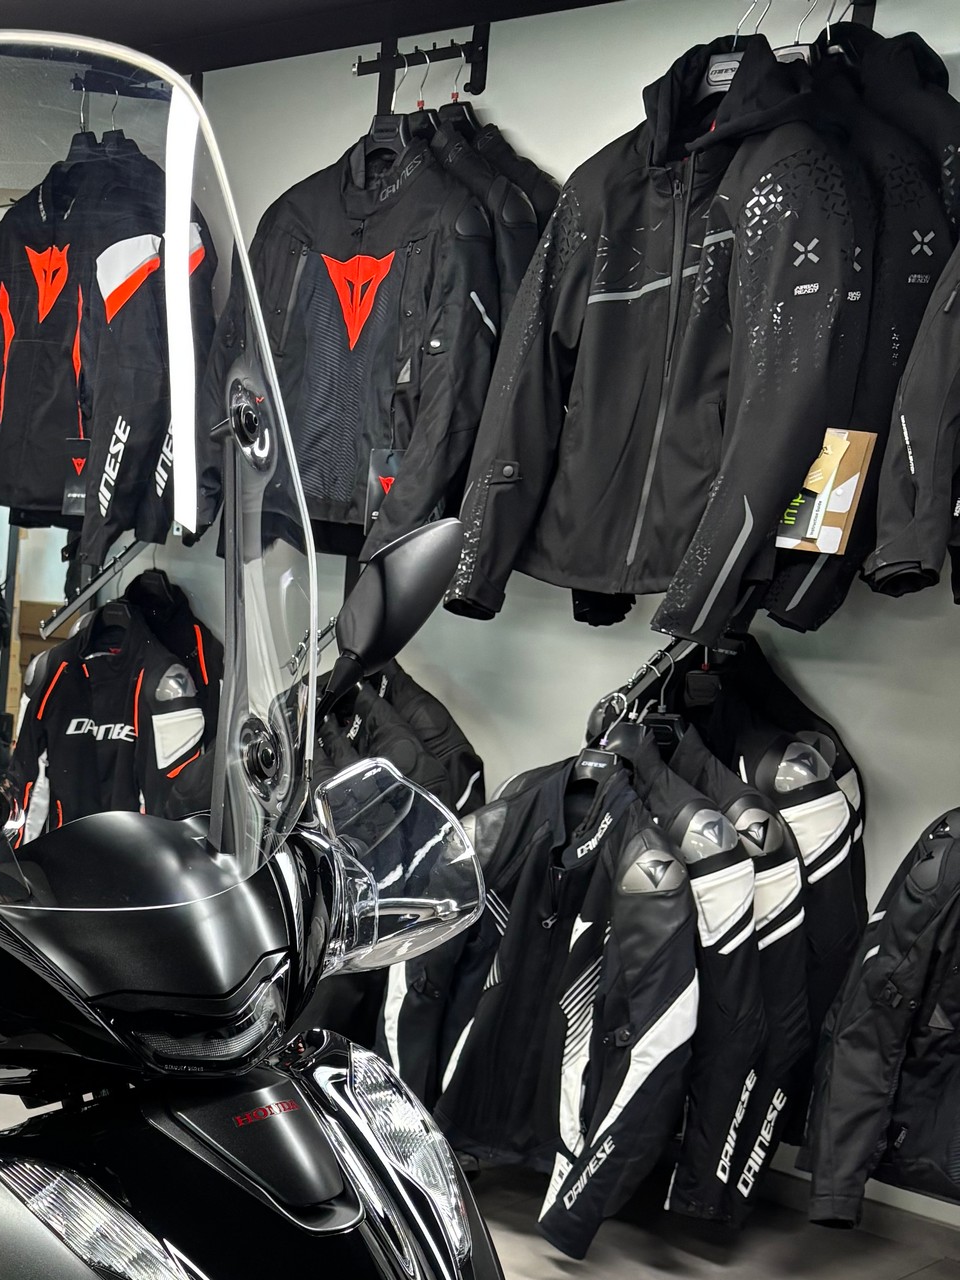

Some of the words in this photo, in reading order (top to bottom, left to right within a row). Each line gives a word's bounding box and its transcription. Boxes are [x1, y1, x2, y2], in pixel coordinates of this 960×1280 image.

[577, 812, 613, 858] DAINESE
[234, 1099, 301, 1128] HONDA
[715, 1069, 758, 1184] DAINESE
[736, 1088, 787, 1198] DAINESE
[562, 1135, 616, 1211] DAINESE
